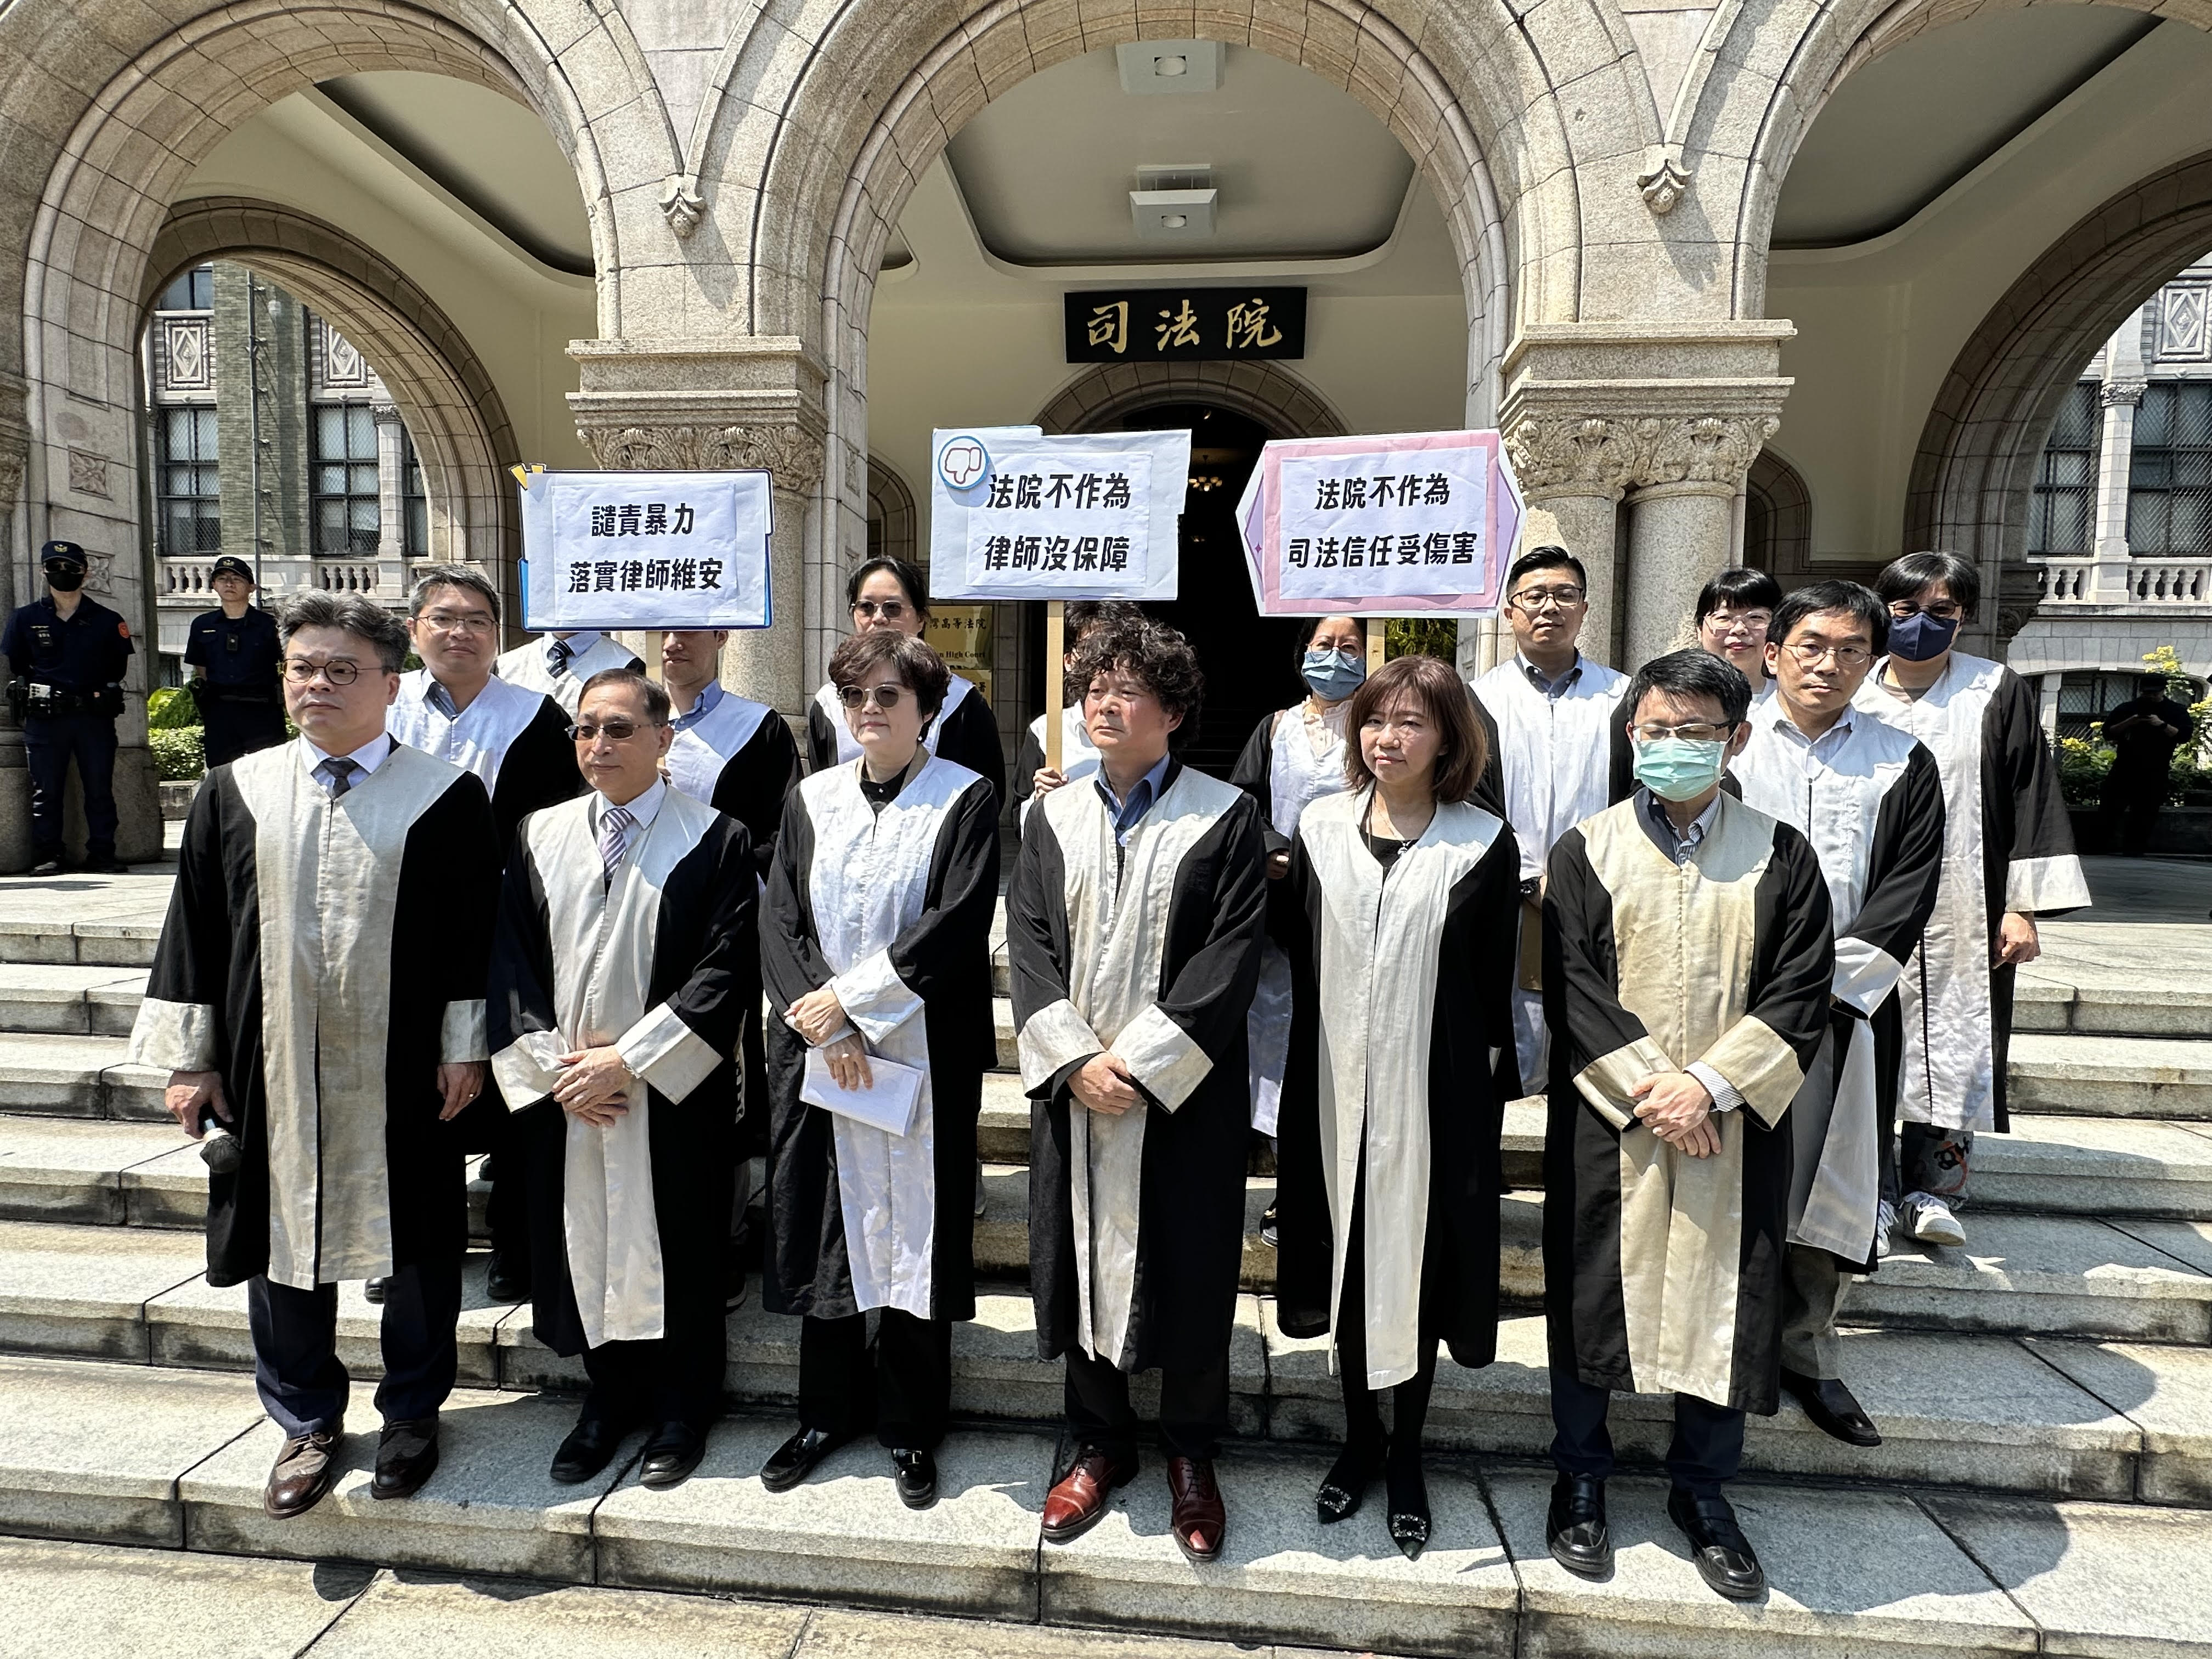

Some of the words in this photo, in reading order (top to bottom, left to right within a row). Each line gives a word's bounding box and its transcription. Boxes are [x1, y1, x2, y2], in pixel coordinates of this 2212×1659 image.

[1087, 298, 1283, 354] 司法院
[986, 472, 1131, 509] 法院不作為
[1314, 473, 1450, 510] 法院不作為
[591, 503, 695, 537] 譴責暴力
[984, 535, 1130, 572] 律師沒保障
[1288, 531, 1477, 568] 司法信任受傷害
[567, 557, 723, 593] 落實律師維安
[925, 618, 986, 629] 灣高等法院
